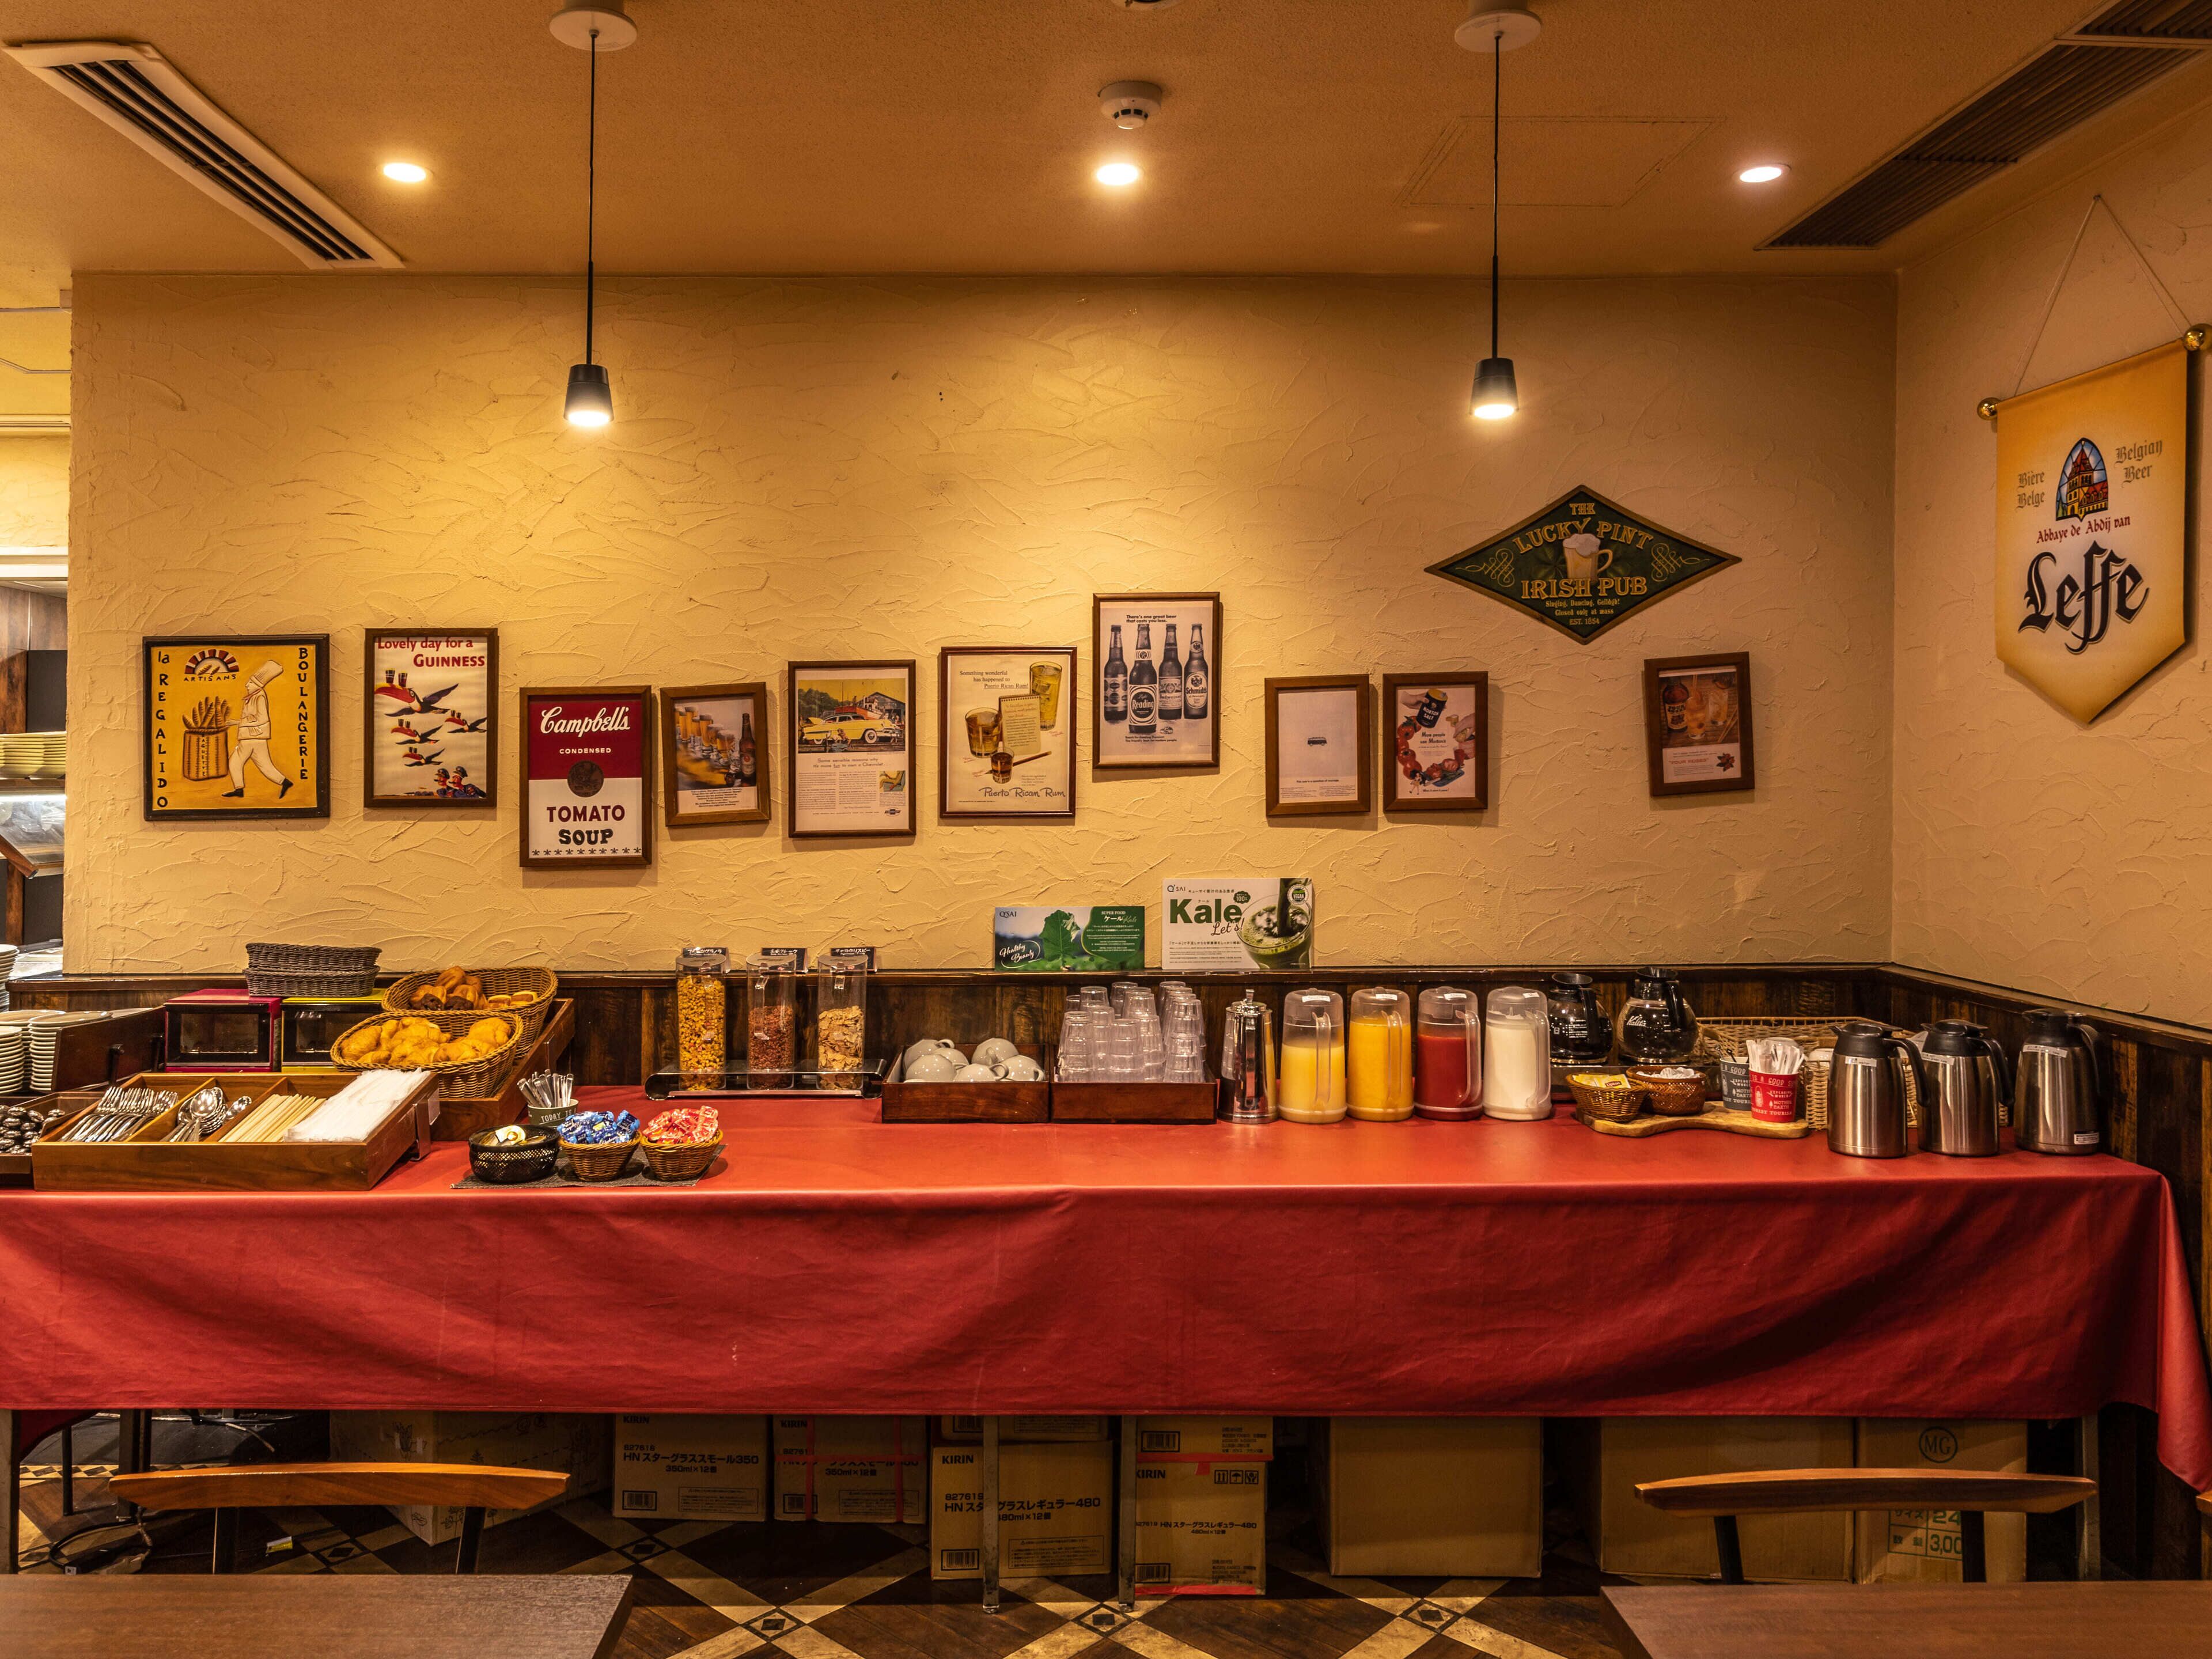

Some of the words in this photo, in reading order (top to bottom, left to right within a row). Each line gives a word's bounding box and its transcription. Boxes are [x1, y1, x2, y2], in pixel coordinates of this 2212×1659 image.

[2115, 440, 2163, 464] Belgian
[2018, 471, 2045, 488] Bière
[2122, 464, 2153, 484] Beer
[2017, 490, 2045, 509] Belge
[1569, 503, 1596, 515] THE
[1513, 517, 1591, 554] LUCKY
[1596, 521, 1654, 550] PINT
[2036, 528, 2068, 544] Abbaye
[2070, 525, 2080, 537] de
[2085, 517, 2111, 534] Abdij
[2114, 516, 2130, 528] van
[1521, 578, 1592, 599] IRISH
[1597, 577, 1647, 596] PUB
[2018, 540, 2150, 655] Leffe
[378, 637, 417, 652] Lovely
[421, 637, 441, 652] day
[445, 637, 463, 648] for
[465, 639, 474, 647] a
[158, 651, 169, 664] la
[413, 653, 486, 667] GUINNESS
[184, 674, 237, 682] ARTISANS
[297, 647, 309, 779] BOULANGERIE
[1132, 699, 1154, 711] Reading
[540, 706, 631, 738] Campbell's
[156, 673, 168, 808] REGALIDO
[979, 787, 1009, 797] Puerto
[1009, 787, 1039, 798] Rican
[1040, 787, 1066, 798] Rum
[547, 805, 625, 823] TOMATO
[558, 828, 613, 846] SOUP
[1170, 899, 1243, 923] Kale
[1211, 918, 1244, 936] Let's!
[999, 944, 1026, 957] Healthy
[1011, 950, 1035, 963] Beauty
[541, 1112, 560, 1122] TODAY
[623, 1415, 650, 1424] KIRIN
[781, 1420, 808, 1428] KIRIN
[1925, 1435, 1951, 1455] MG
[624, 1453, 640, 1461] HN
[942, 1455, 974, 1464] KIRIN
[945, 1502, 963, 1512] HN
[966, 1498, 1101, 1512] スタグラスレギュラー480
